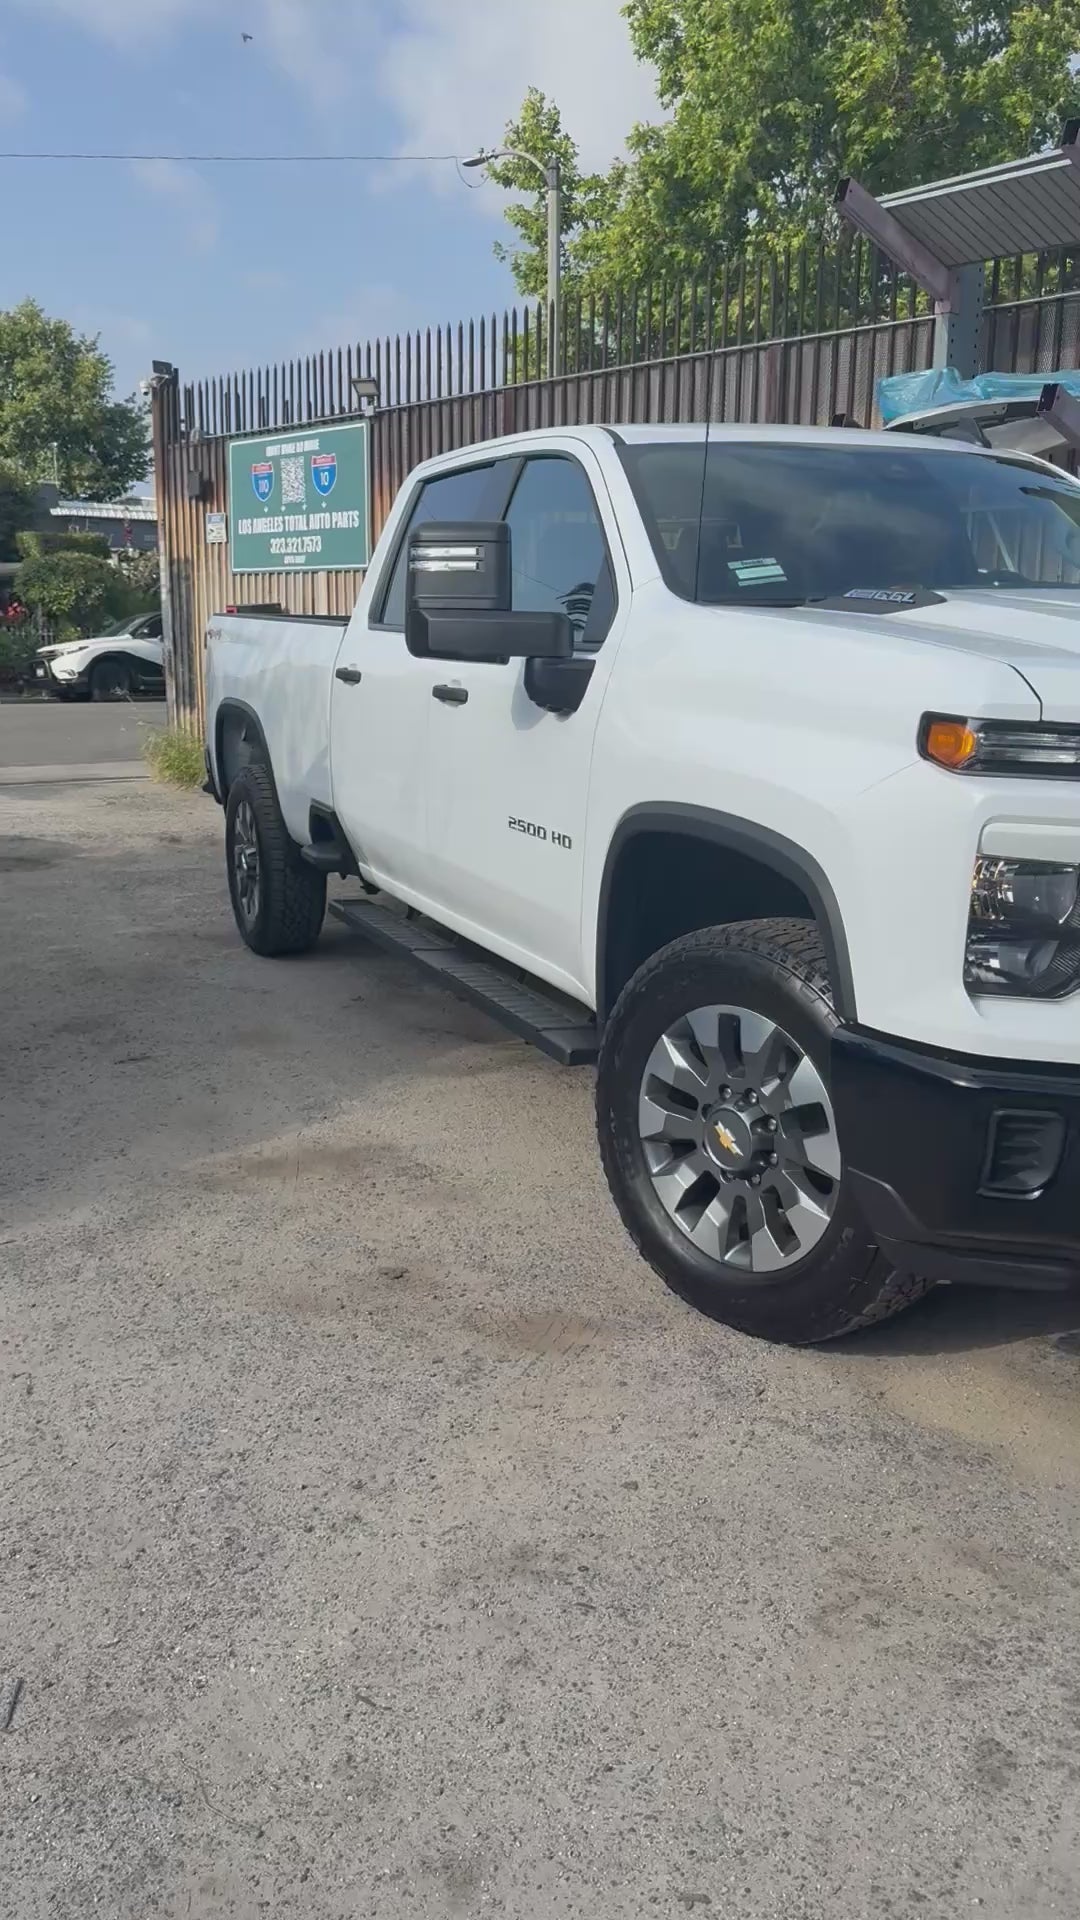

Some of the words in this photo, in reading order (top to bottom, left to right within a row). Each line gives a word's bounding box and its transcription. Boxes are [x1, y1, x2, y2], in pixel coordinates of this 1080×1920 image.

[320, 471, 330, 486] 10
[238, 518, 252, 535] LOS
[252, 515, 284, 534] ANGELES
[284, 514, 308, 532] TOTAL
[309, 512, 331, 530] AUTO
[332, 510, 360, 529] PARTS
[508, 815, 547, 841] 2500
[551, 830, 572, 850] HD
